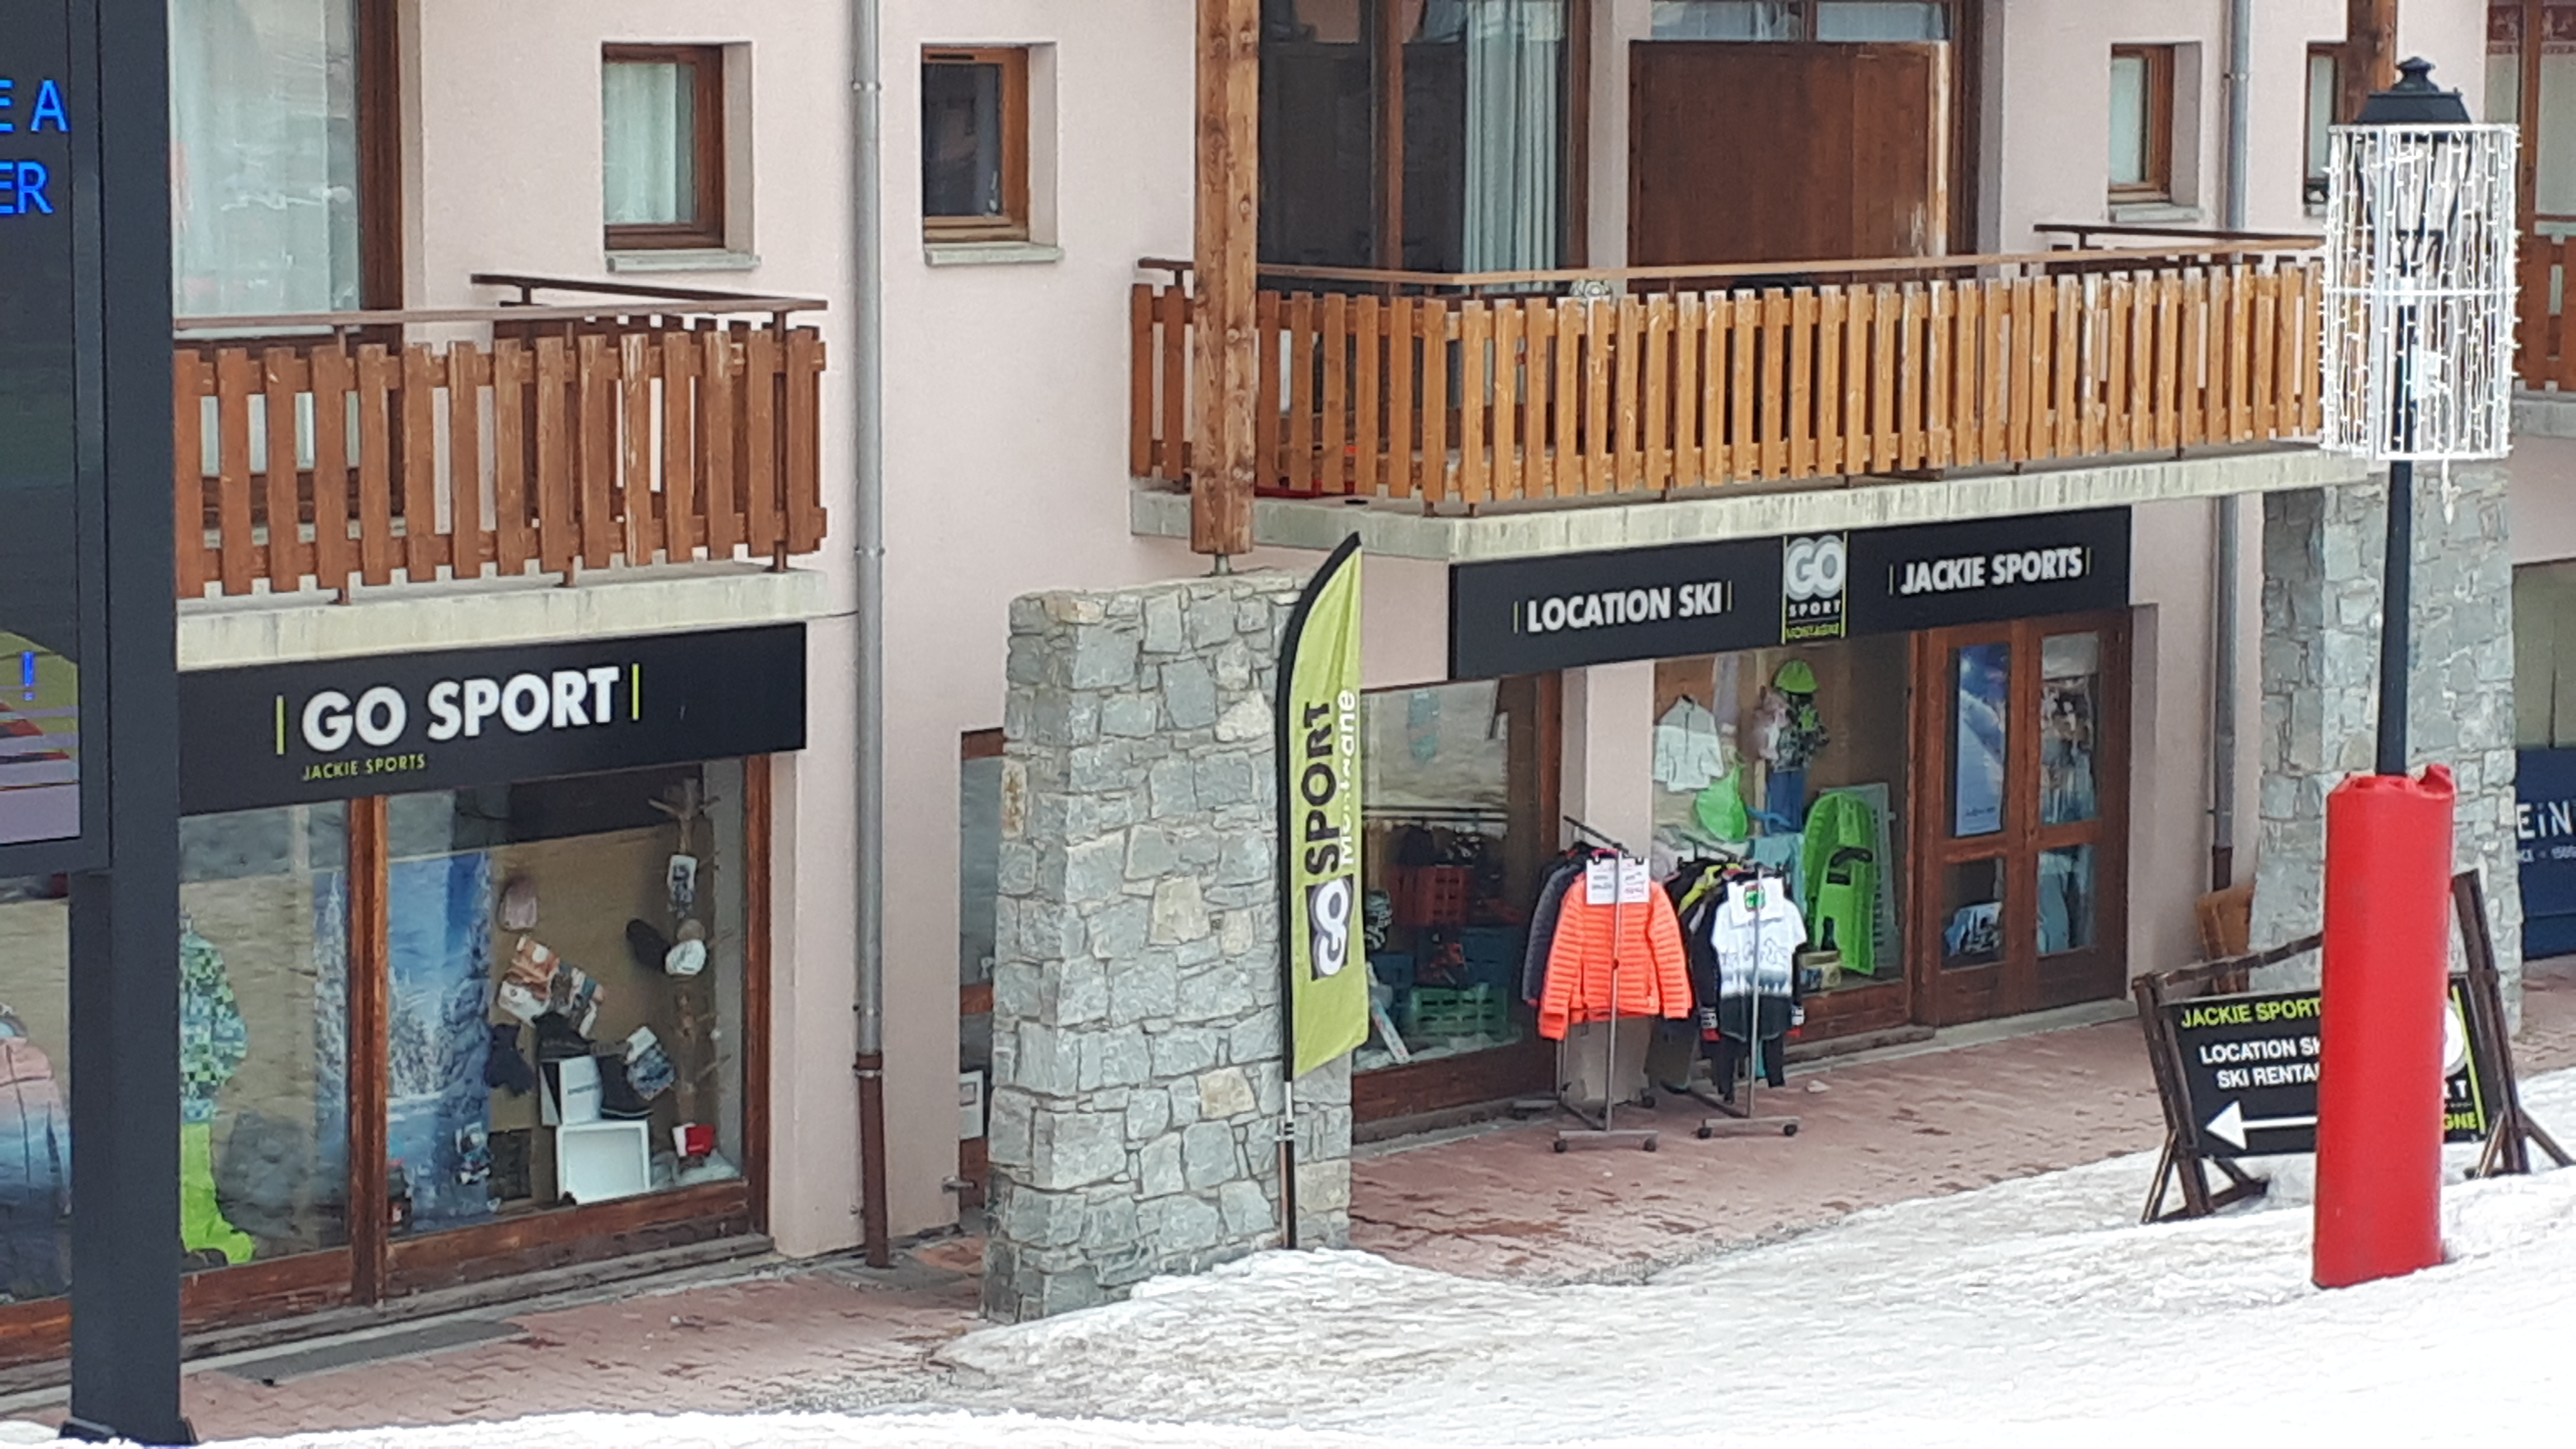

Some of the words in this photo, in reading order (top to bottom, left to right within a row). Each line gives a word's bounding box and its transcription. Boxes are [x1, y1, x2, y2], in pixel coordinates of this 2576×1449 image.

[30, 79, 68, 132] A
[1787, 535, 1844, 602] GO
[1900, 557, 1985, 594] JACKIE
[1991, 548, 2082, 585] SPORTS
[1527, 587, 1671, 633] LOCATION
[1678, 581, 1722, 618] SKI
[1789, 599, 1841, 617] SPORT
[302, 686, 407, 752] GO
[427, 666, 619, 740] SPORT
[303, 760, 359, 781] JACKIE
[366, 754, 425, 774] SPORTS
[1300, 701, 1340, 876] SPORT
[1308, 876, 1351, 978] GO
[2181, 1004, 2253, 1027] JACKIE
[2256, 997, 2322, 1021] SPORT
[2199, 1039, 2297, 1064] LOCATION
[2217, 1068, 2250, 1090] SKI
